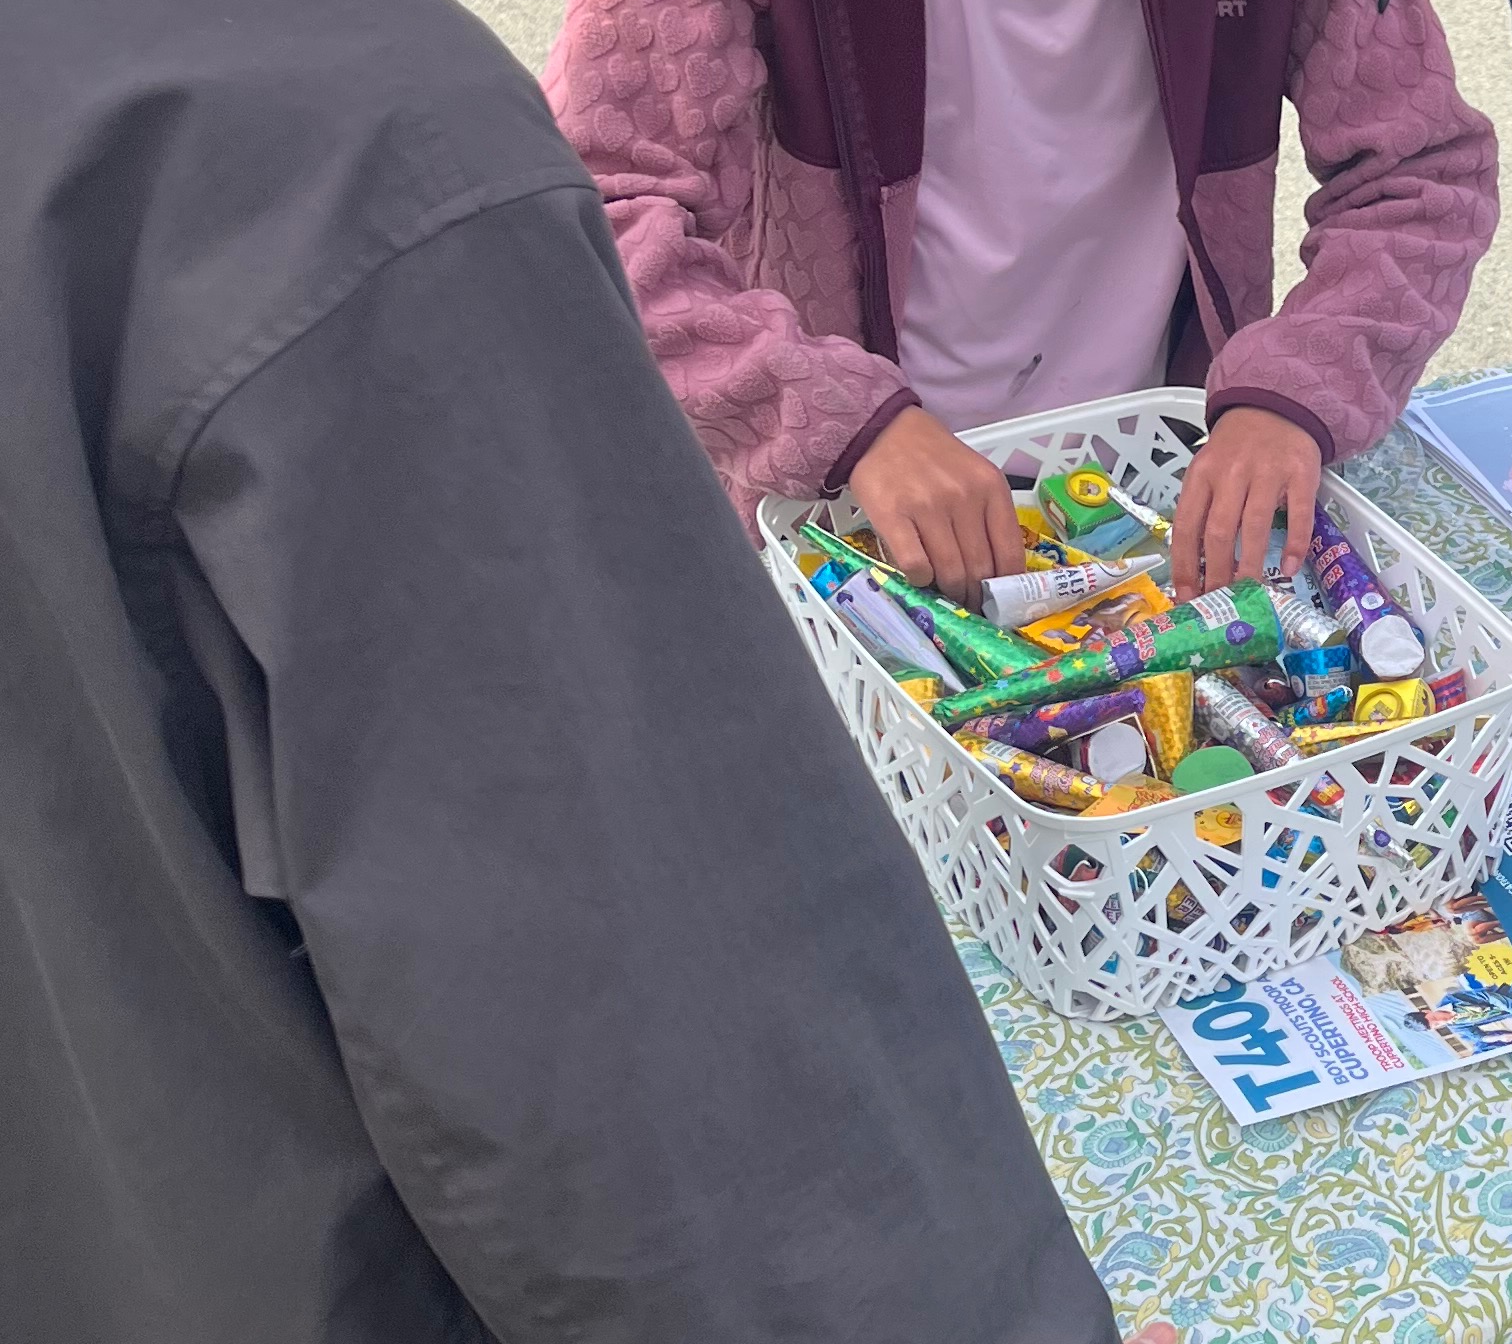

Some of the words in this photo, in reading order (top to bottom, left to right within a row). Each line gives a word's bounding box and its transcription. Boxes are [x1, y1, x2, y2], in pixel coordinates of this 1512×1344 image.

[1280, 977, 1304, 995] CA
[1330, 975, 1357, 1002] SCHOOL
[1330, 994, 1344, 1002] AT
[1262, 985, 1296, 1016] TROOP
[1349, 1002, 1371, 1022] HIGH
[1289, 1015, 1329, 1057] SCOUTS
[1289, 994, 1367, 1079] CUPERTINO,
[1339, 1003, 1378, 1042] MEETINGS
[1361, 1023, 1404, 1068] CUPERTINO
[1367, 1043, 1392, 1071] TROOP
[1320, 1060, 1349, 1084] BOY
